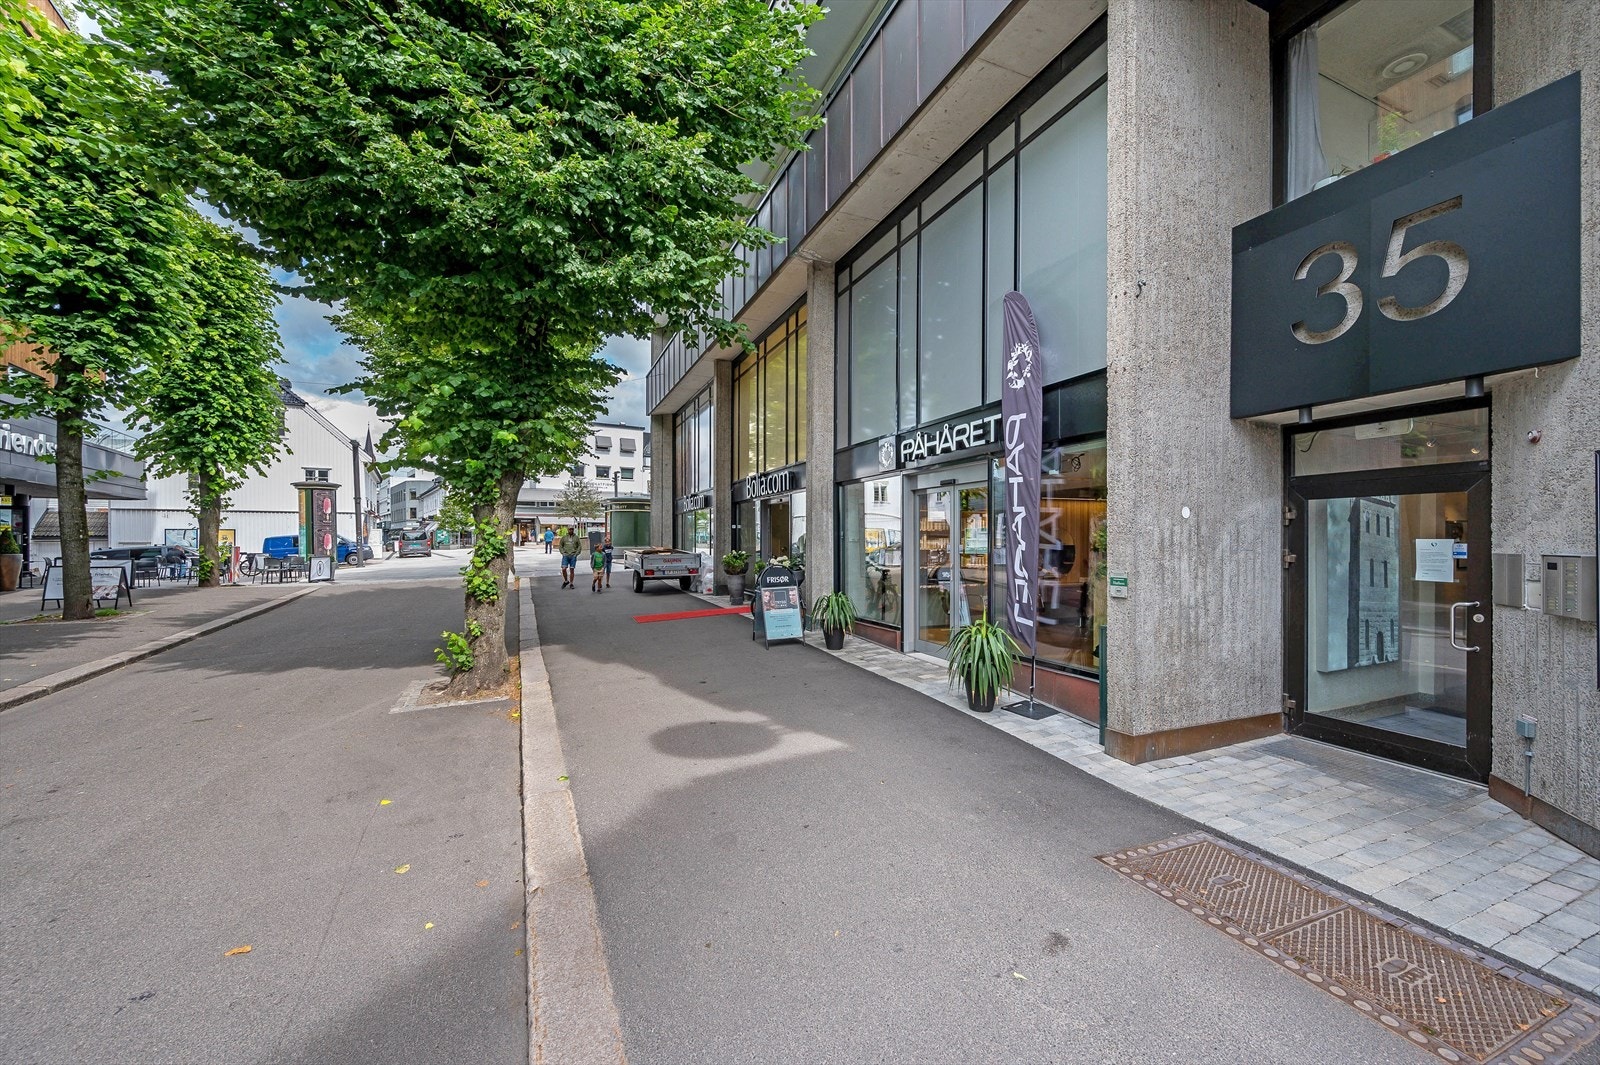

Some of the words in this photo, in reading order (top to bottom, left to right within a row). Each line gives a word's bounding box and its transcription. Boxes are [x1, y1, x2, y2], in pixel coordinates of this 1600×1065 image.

[1290, 194, 1470, 345] 35
[901, 413, 1002, 463] PÅHÅRET
[746, 470, 790, 499] Bolia.com
[766, 575, 790, 584] FRISØR
